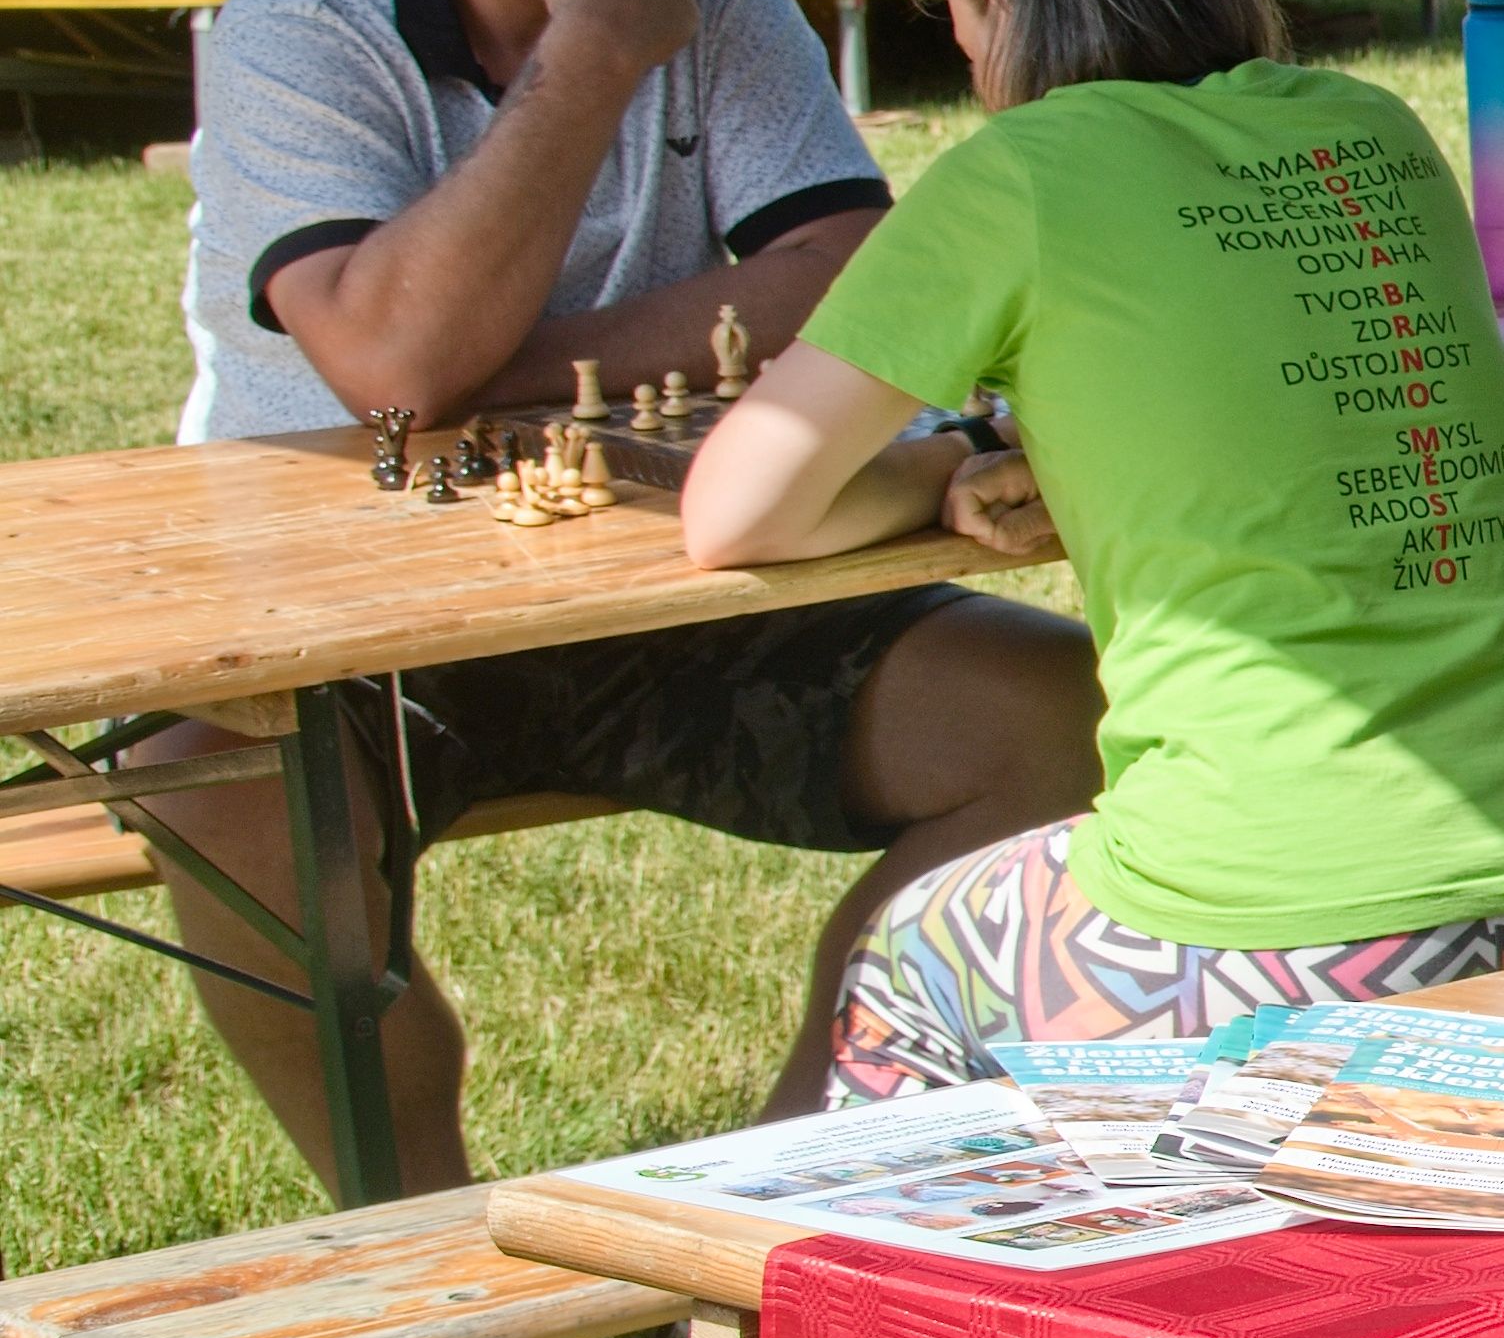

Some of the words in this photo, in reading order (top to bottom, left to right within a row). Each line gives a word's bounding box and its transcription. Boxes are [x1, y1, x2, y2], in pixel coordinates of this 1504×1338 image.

[1218, 137, 1385, 182] KAMARÁDI
[1260, 152, 1441, 199] POROZUMĚNÍ
[1179, 186, 1406, 228] SPOLEČENSTVÍ
[1217, 216, 1427, 252] KOMUNIKACE
[1297, 243, 1431, 275] ODVAHA
[1295, 282, 1425, 316] TVORBA
[1352, 306, 1457, 343] ZDRAVÍ
[1281, 344, 1472, 386] DŮSTOJNOST
[1335, 380, 1448, 416] POMOC
[1397, 422, 1484, 455] SMYSL
[1349, 491, 1459, 529] RADOST
[1393, 555, 1473, 591] ŽIVOT
[1327, 1006, 1487, 1034] Žijeme
[1025, 1045, 1184, 1059] Žijeme
